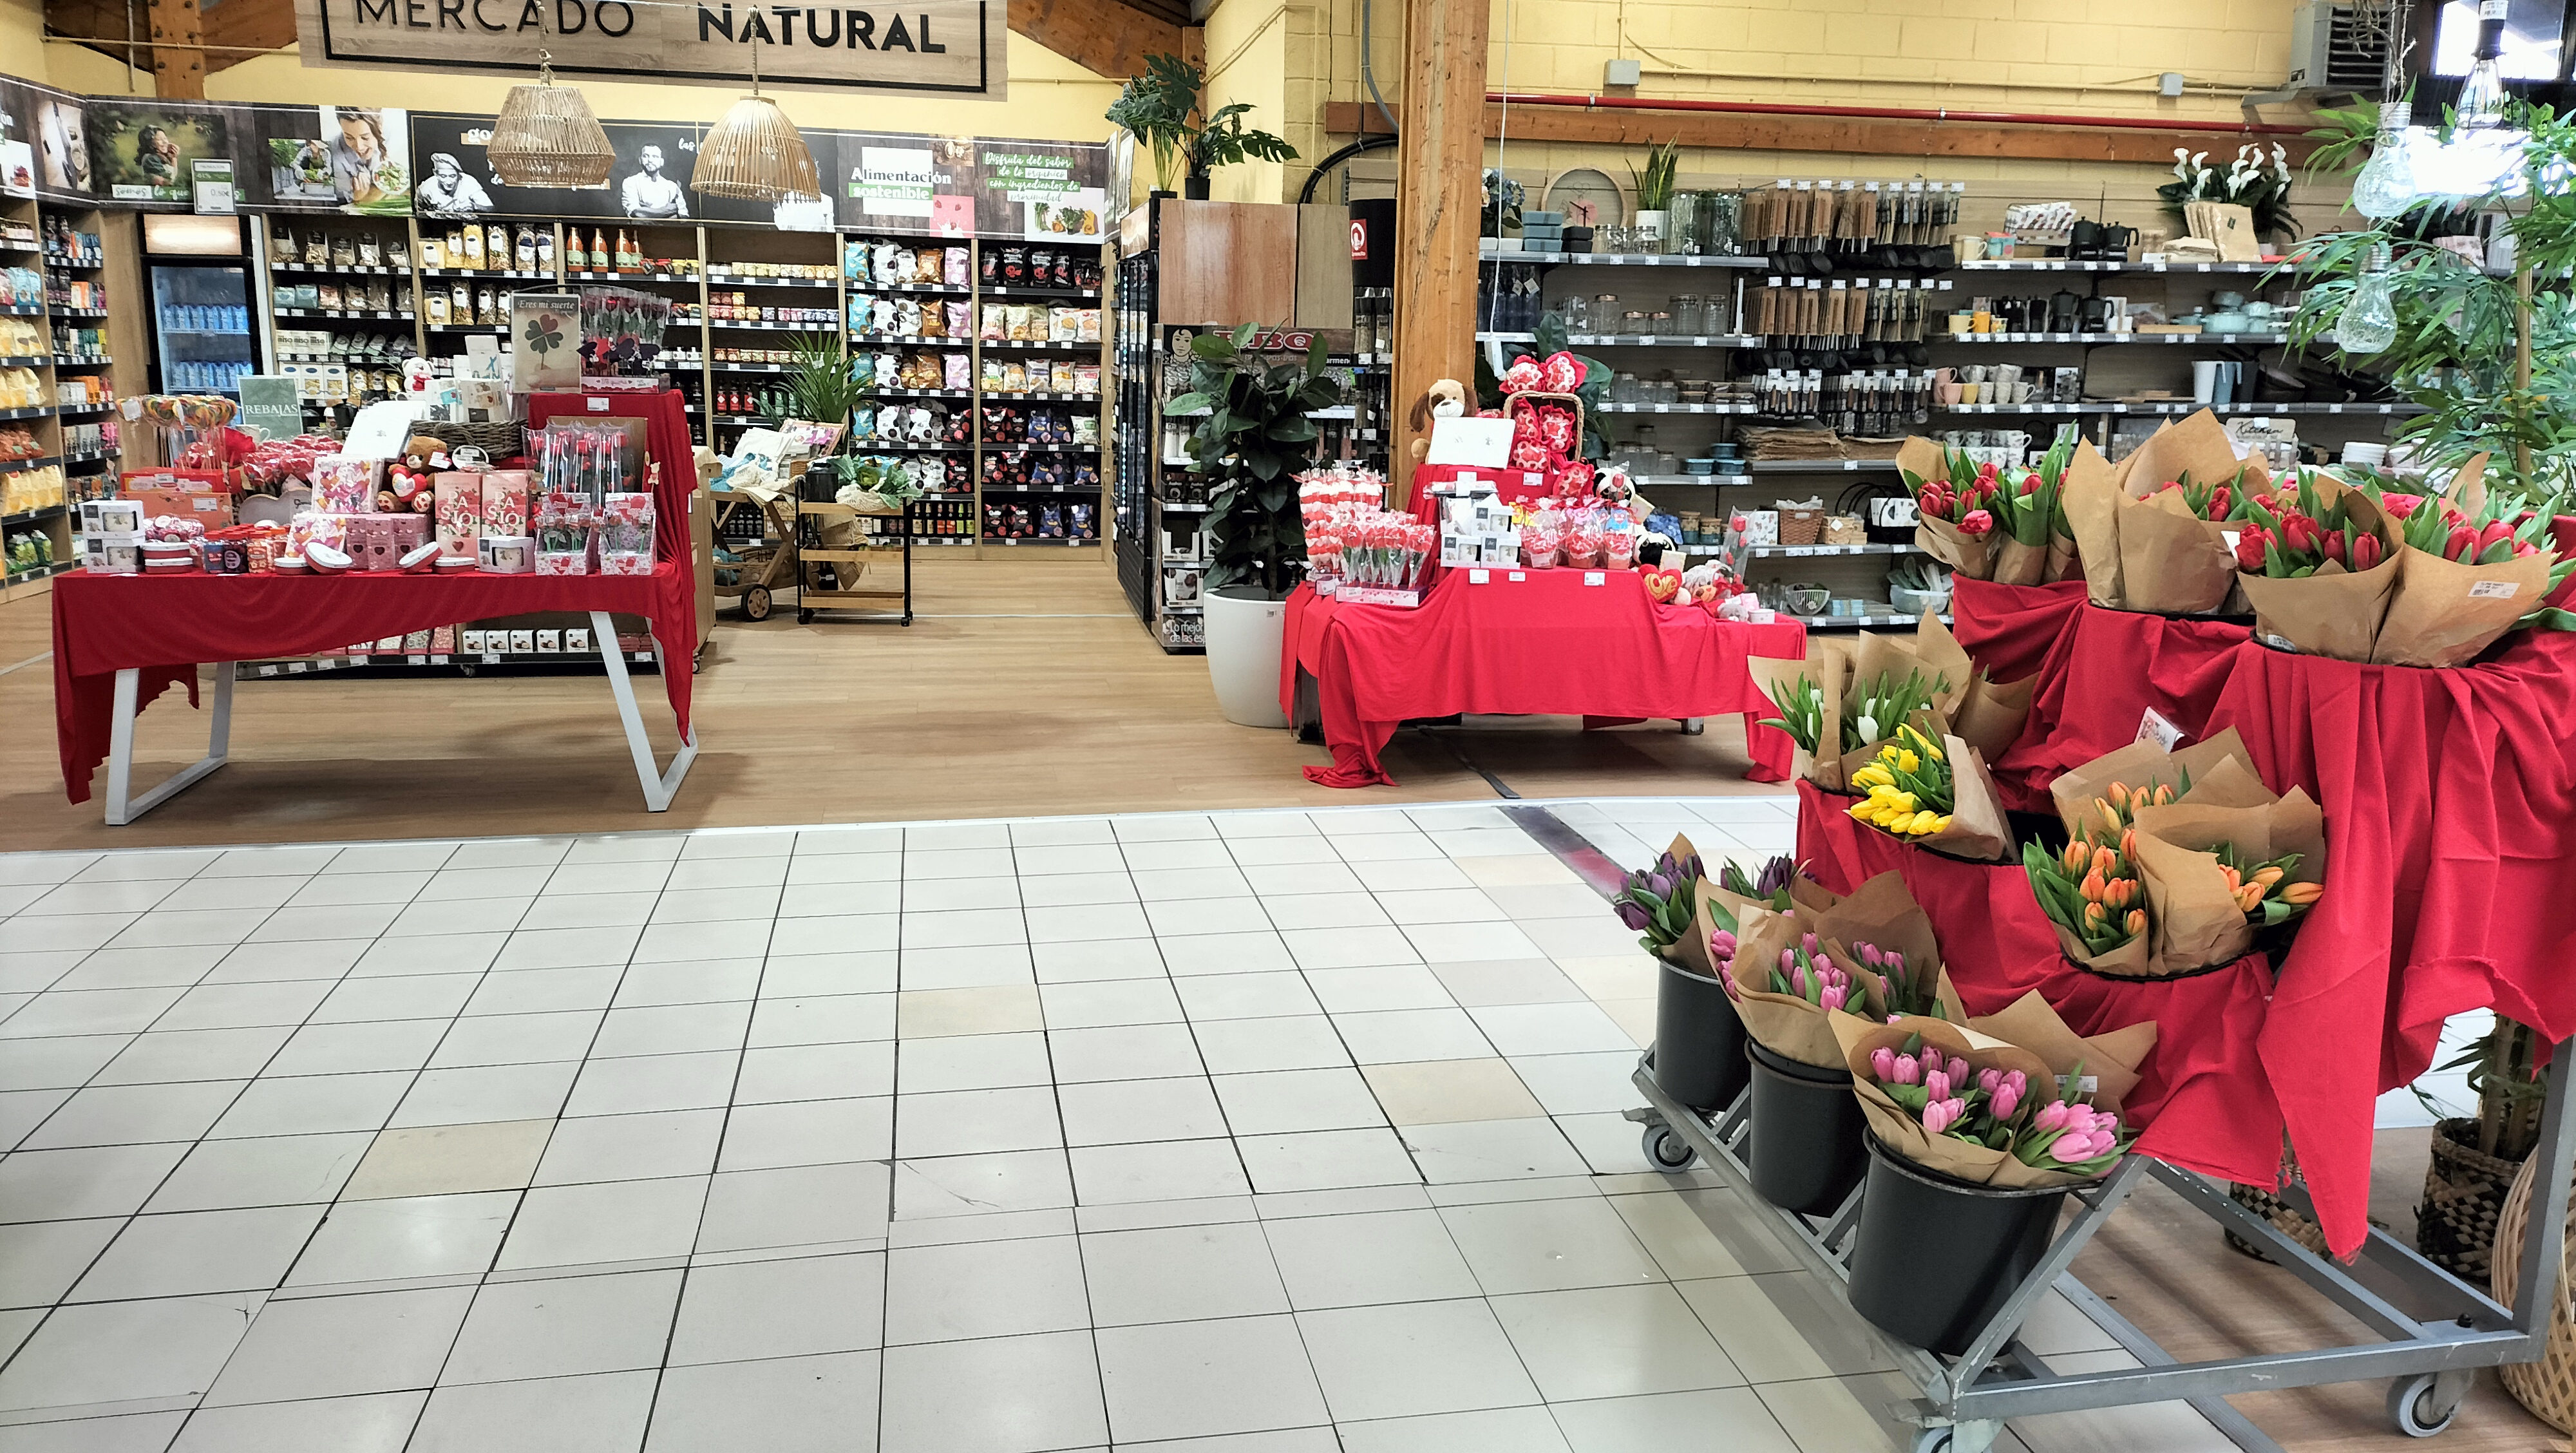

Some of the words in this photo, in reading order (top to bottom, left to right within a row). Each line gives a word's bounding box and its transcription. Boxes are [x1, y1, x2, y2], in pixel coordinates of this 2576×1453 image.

[356, 0, 634, 37] MERCADO
[698, 1, 946, 53] NATURAL
[985, 151, 1024, 166] Disfruta
[1026, 154, 1043, 165] del
[1045, 156, 1072, 167] sabor
[851, 167, 952, 185] Alimentación
[998, 166, 1011, 176] de
[1013, 166, 1023, 176] lo
[1009, 178, 1065, 191] ingredientes
[1066, 180, 1079, 191] de
[115, 187, 147, 197] somos
[154, 184, 166, 197] lo
[169, 189, 189, 200] que
[853, 185, 929, 200] sostenible
[1010, 193, 1063, 203] proximidad
[517, 299, 537, 309] Eres
[538, 300, 549, 309] mi
[245, 403, 298, 417] REBAJAS
[1180, 622, 1203, 635] mejor
[1170, 632, 1180, 643] de
[1182, 631, 1193, 643] las
